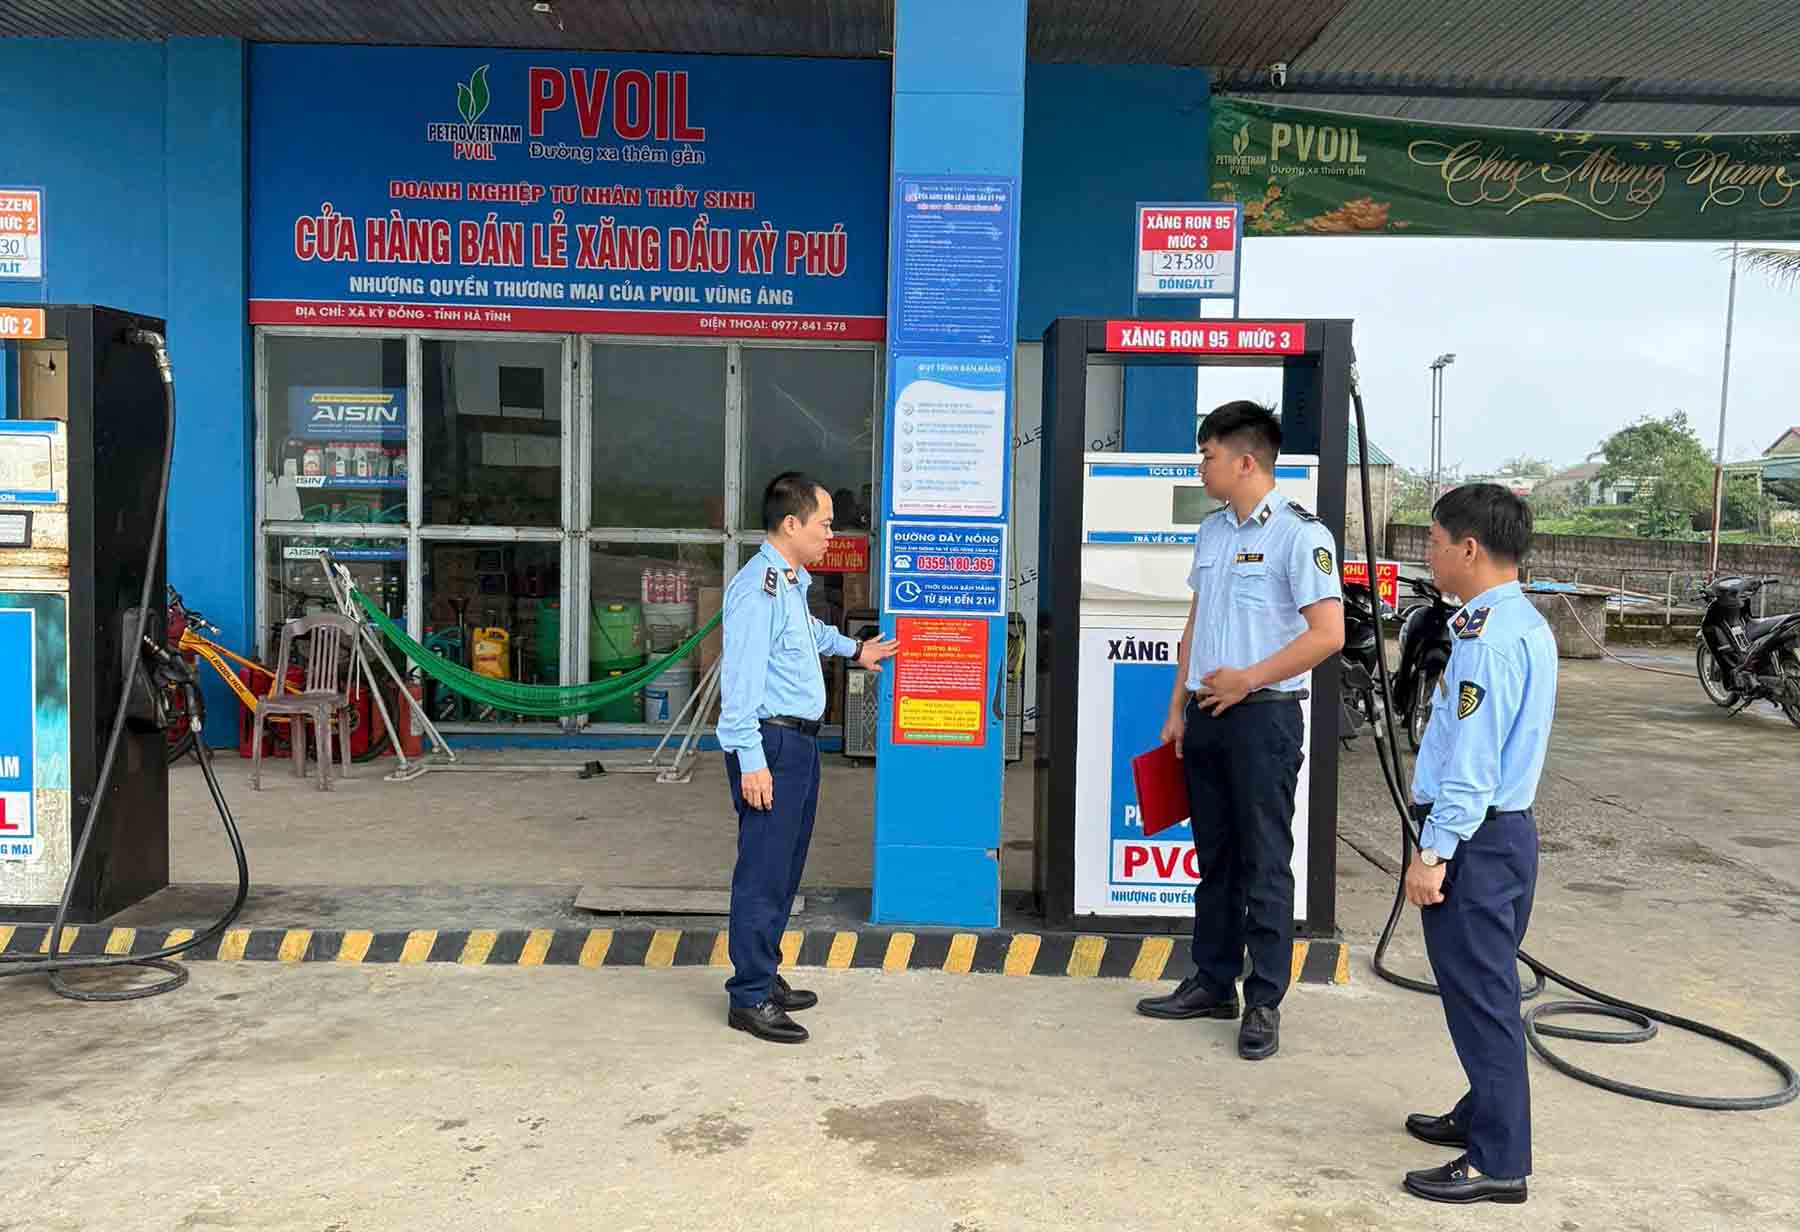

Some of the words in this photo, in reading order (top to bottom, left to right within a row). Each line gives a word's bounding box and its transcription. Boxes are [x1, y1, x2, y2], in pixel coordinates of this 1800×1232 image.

[528, 66, 706, 142] PVOIL
[427, 122, 522, 144] PETROVIETNAM
[453, 142, 496, 161] PVOIL
[1271, 122, 1367, 164] PVOIL
[529, 141, 593, 164] Đường
[596, 149, 619, 161] xa
[622, 145, 667, 162] thêm
[671, 143, 705, 167] gần
[1408, 140, 1545, 206] Chúc
[390, 180, 461, 200] DOANH
[467, 180, 545, 205] NGHIỆP
[551, 184, 578, 205] TƯ
[582, 184, 641, 206] NHÂN
[646, 184, 699, 208] THỦY
[704, 190, 756, 209] SINH
[27, 218, 36, 231] 2
[1147, 213, 1182, 229] XĂNG
[1185, 217, 1211, 229] RON
[1215, 217, 1231, 229] 95
[294, 202, 359, 262] CỬA
[365, 210, 452, 264] HÀNG
[458, 212, 525, 267] BÁN
[532, 207, 569, 269] LẺ
[575, 216, 661, 271] XĂNG
[667, 213, 731, 274] DẦU
[737, 221, 779, 275] KỲ
[784, 223, 848, 277] PHÚ
[1168, 235, 1196, 249] MỨC
[1200, 236, 1208, 249] 3
[1161, 253, 1215, 271] 27580
[349, 275, 424, 297] NHƯỢNG
[430, 274, 489, 297] QUYỀN
[493, 279, 564, 299] THƯƠNG
[568, 283, 603, 303] MẠI
[608, 280, 646, 302] CỦA
[649, 286, 700, 304] PVOIL
[295, 306, 316, 319] ĐỊA
[23, 319, 33, 334] 2
[700, 318, 727, 331] ĐIỆN
[770, 321, 848, 332] 0977.841.578
[1121, 327, 1165, 348] XĂNG
[1170, 331, 1204, 348] RON
[1209, 331, 1228, 348] 95
[1238, 328, 1275, 348] MỨC
[1281, 332, 1291, 349] 3
[312, 406, 399, 422] AISIN
[894, 533, 936, 542] ĐƯỜNG
[917, 555, 995, 571] 0359.180.369
[1344, 564, 1365, 575] KHU
[939, 596, 952, 606] 5H
[976, 597, 995, 606] 21H
[1108, 636, 1169, 661] XĂNG
[1111, 889, 1156, 903] NHƯỢNG
